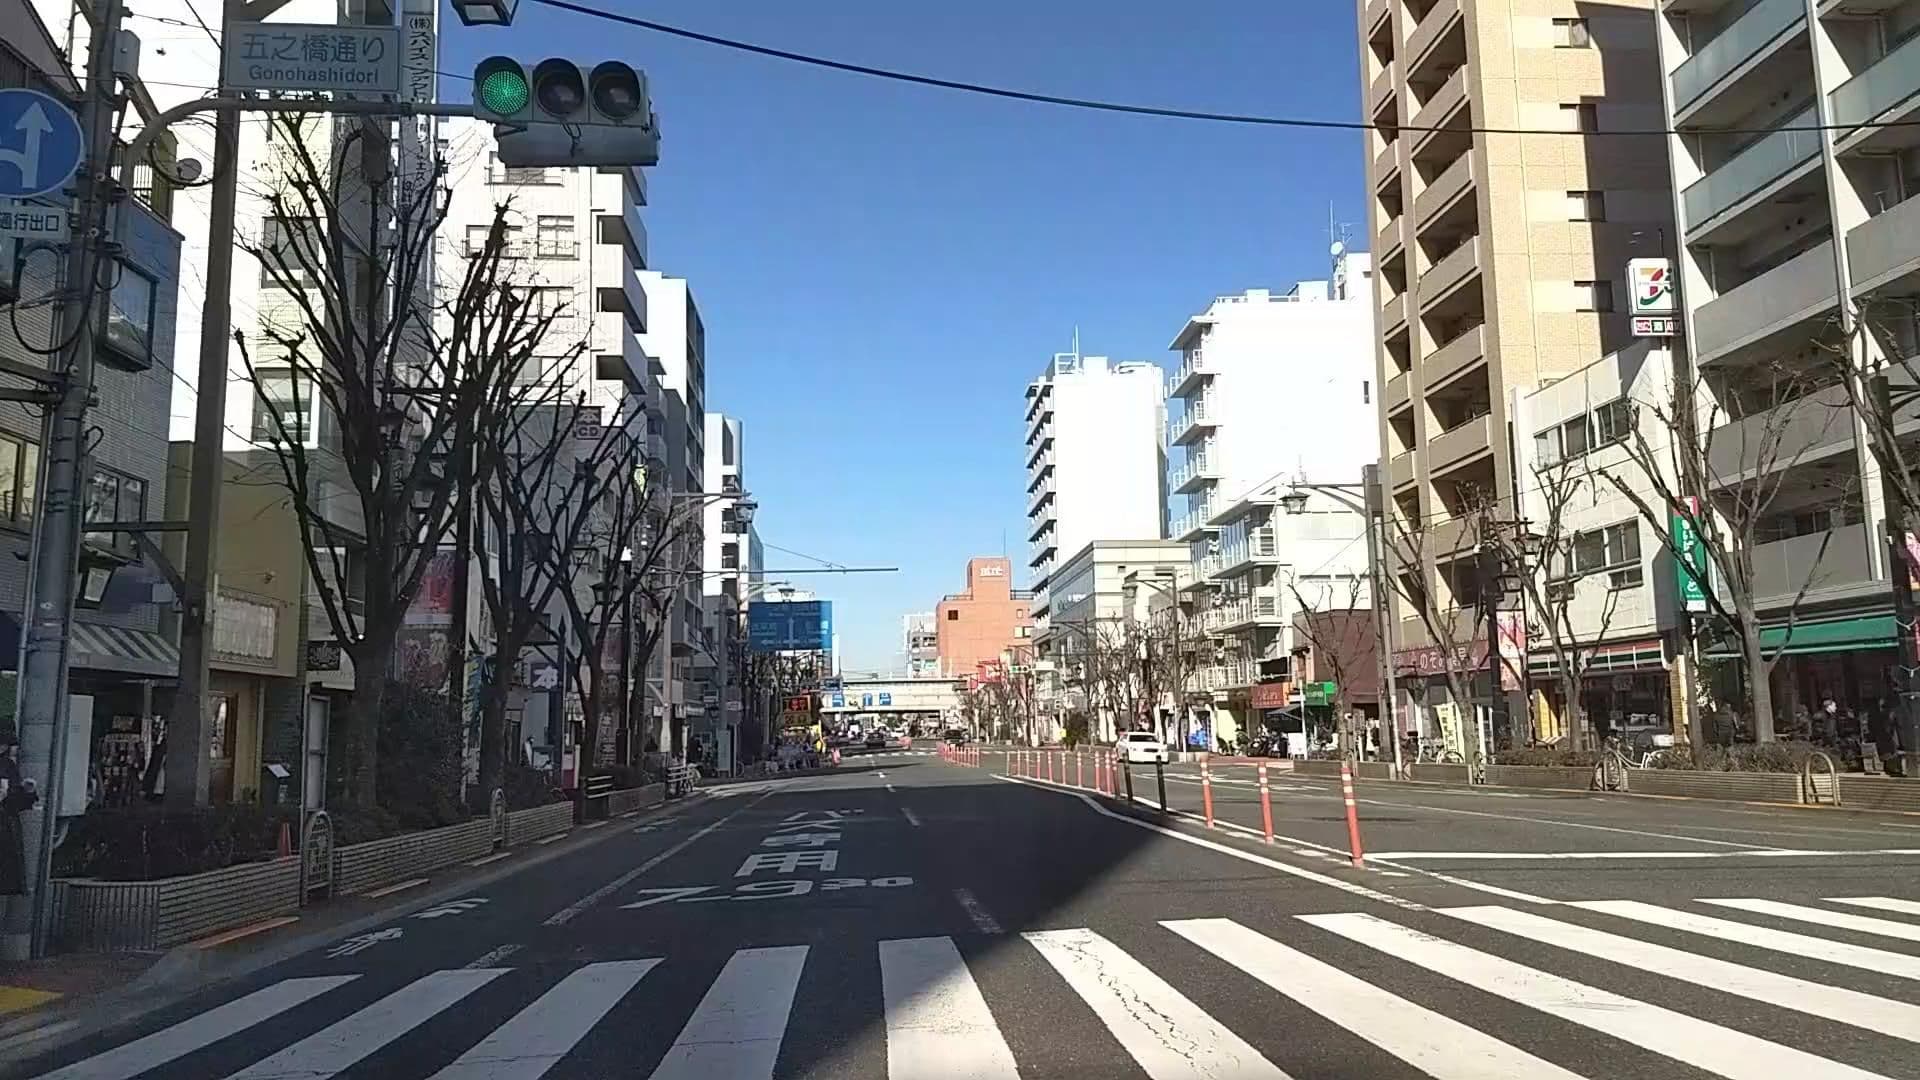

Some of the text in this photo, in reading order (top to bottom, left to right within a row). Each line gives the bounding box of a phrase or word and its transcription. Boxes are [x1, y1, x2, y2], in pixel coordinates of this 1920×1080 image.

[240, 32, 384, 63] 五之橋通り
[249, 64, 379, 84] Gonohashidori
[578, 426, 599, 437] CD
[734, 809, 864, 877] バス専用
